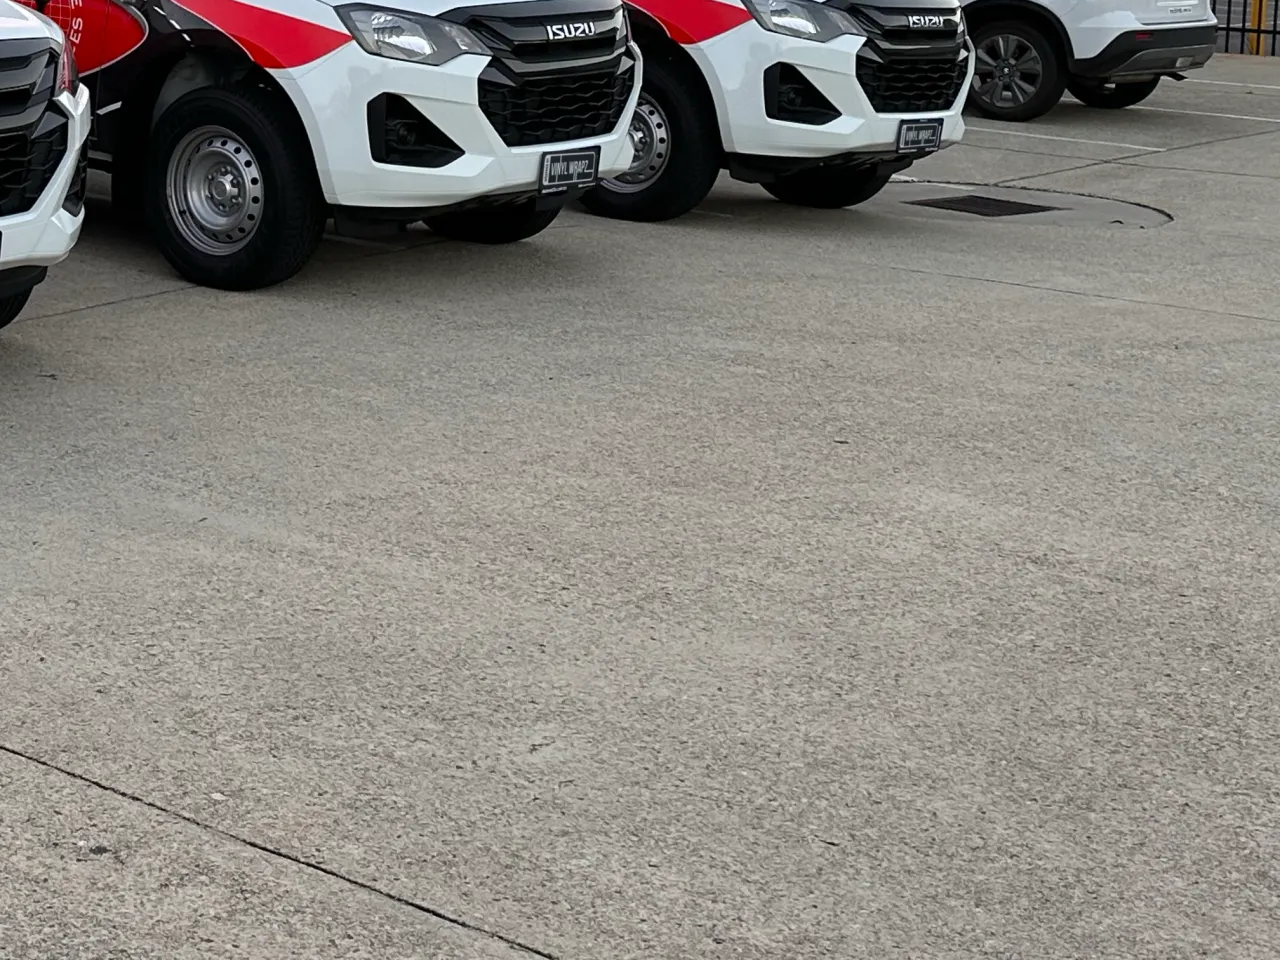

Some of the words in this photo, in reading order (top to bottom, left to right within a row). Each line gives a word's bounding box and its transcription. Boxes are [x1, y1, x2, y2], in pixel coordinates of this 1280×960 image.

[907, 15, 944, 28] ISUZU
[546, 21, 595, 40] ISUZU
[551, 161, 568, 176] VINYL
[569, 160, 589, 174] WRAPZ
